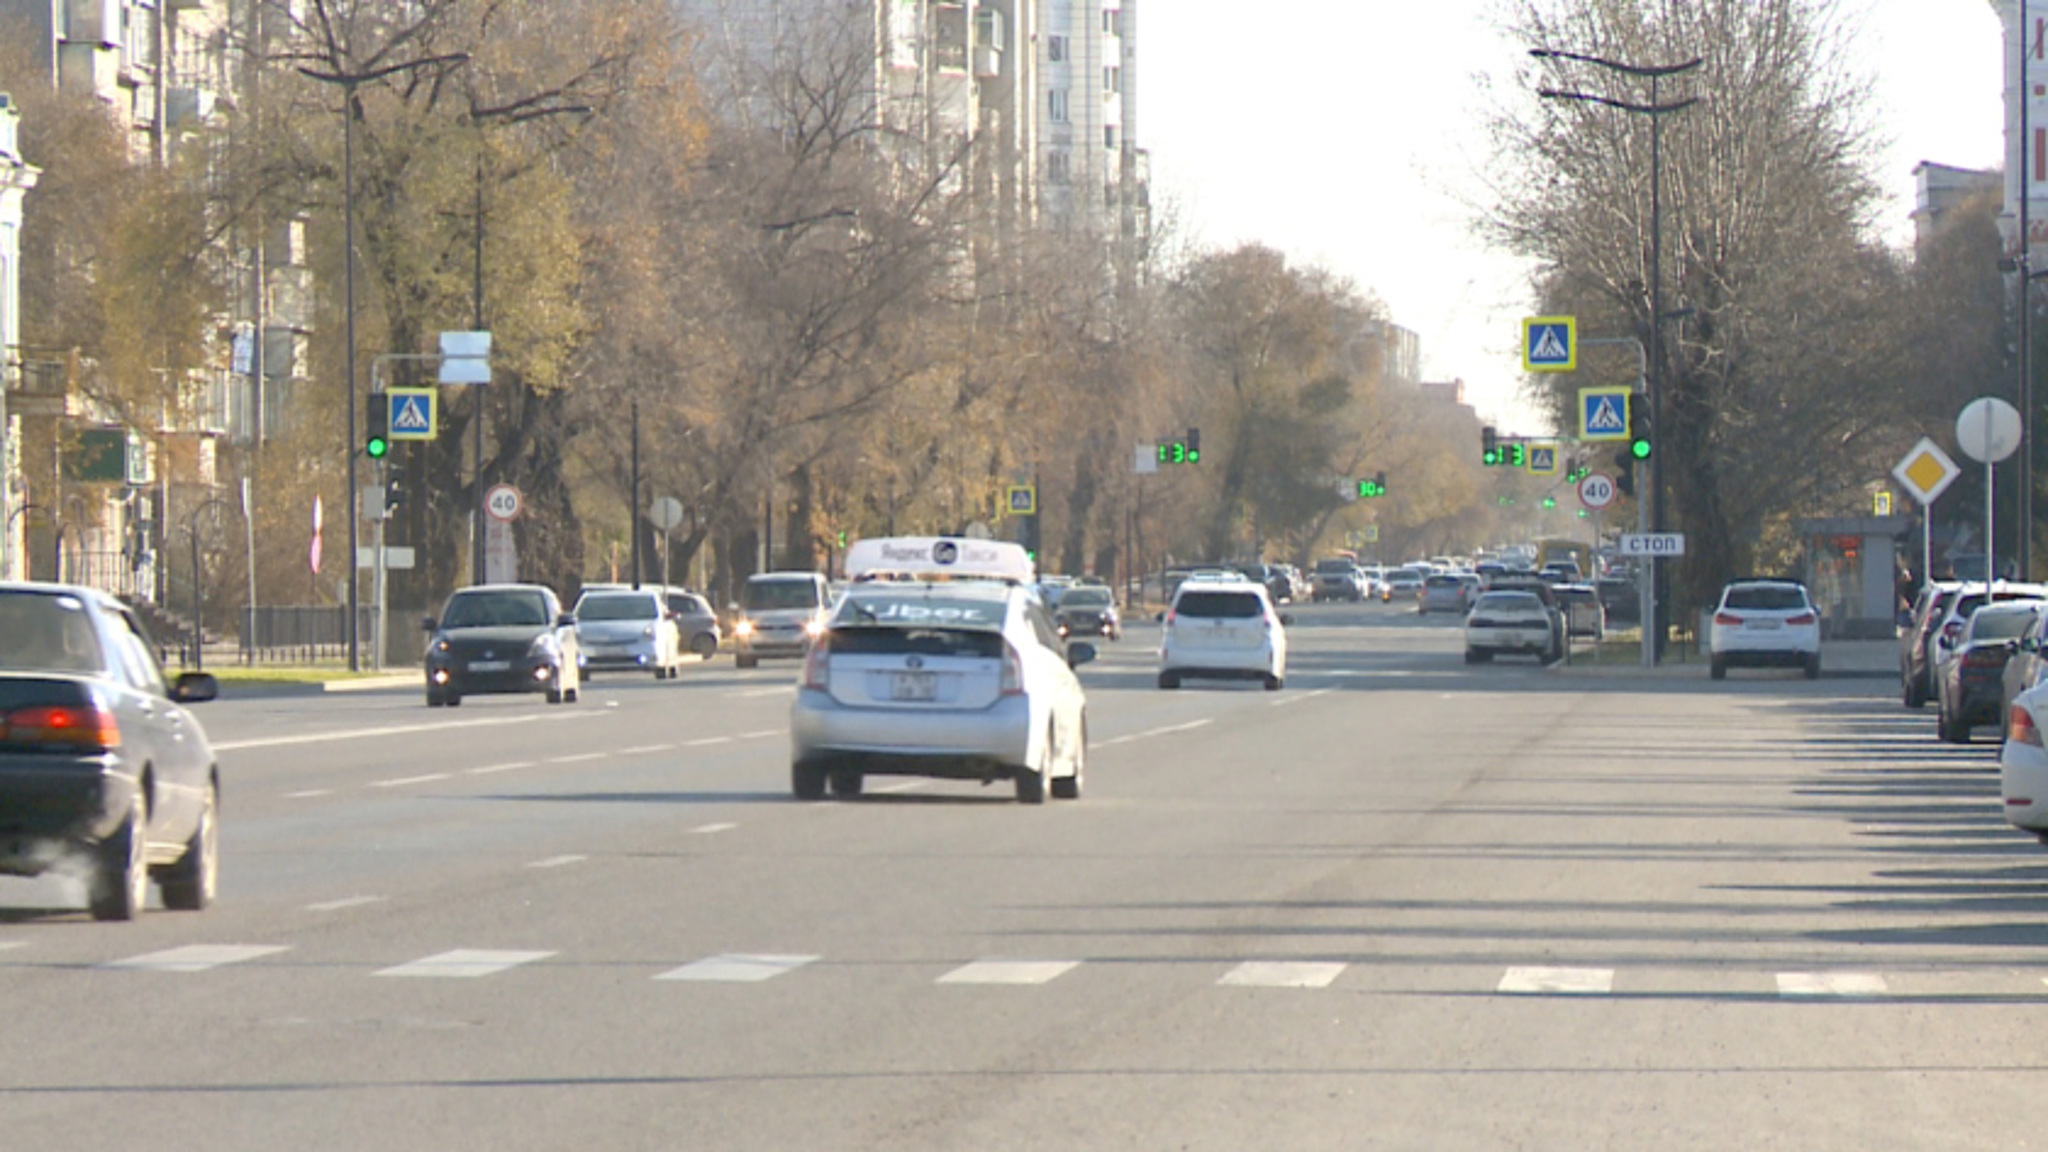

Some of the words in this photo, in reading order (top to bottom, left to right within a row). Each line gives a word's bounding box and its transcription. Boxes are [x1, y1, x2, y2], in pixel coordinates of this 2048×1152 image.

[1159, 442, 1184, 464] 13
[1497, 444, 1524, 466] 13
[1359, 480, 1376, 497] 30
[1584, 482, 1611, 499] 40
[492, 494, 516, 511] 40
[1630, 537, 1676, 552] СТОП
